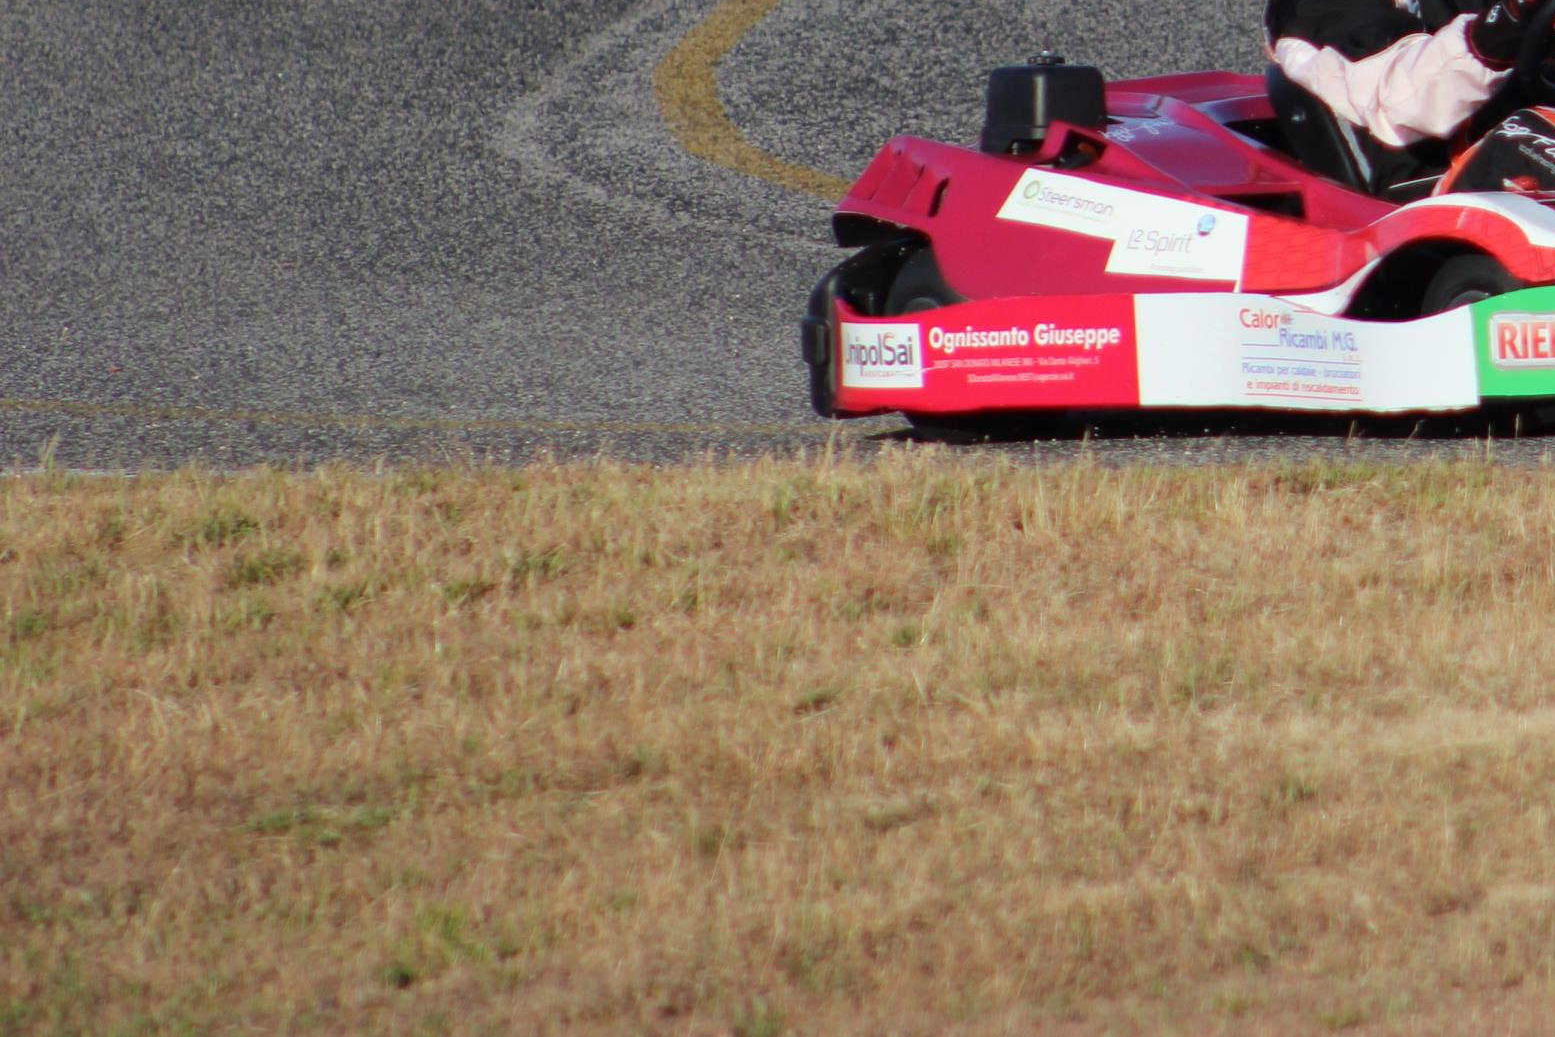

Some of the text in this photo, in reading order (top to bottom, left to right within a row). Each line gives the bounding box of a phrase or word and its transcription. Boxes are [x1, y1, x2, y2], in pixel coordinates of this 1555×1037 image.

[1038, 186, 1116, 218] Steersman
[1239, 308, 1279, 329] Calor
[928, 323, 1121, 353] Ognissanto Giuseppe
[1279, 327, 1328, 350] Ricambi
